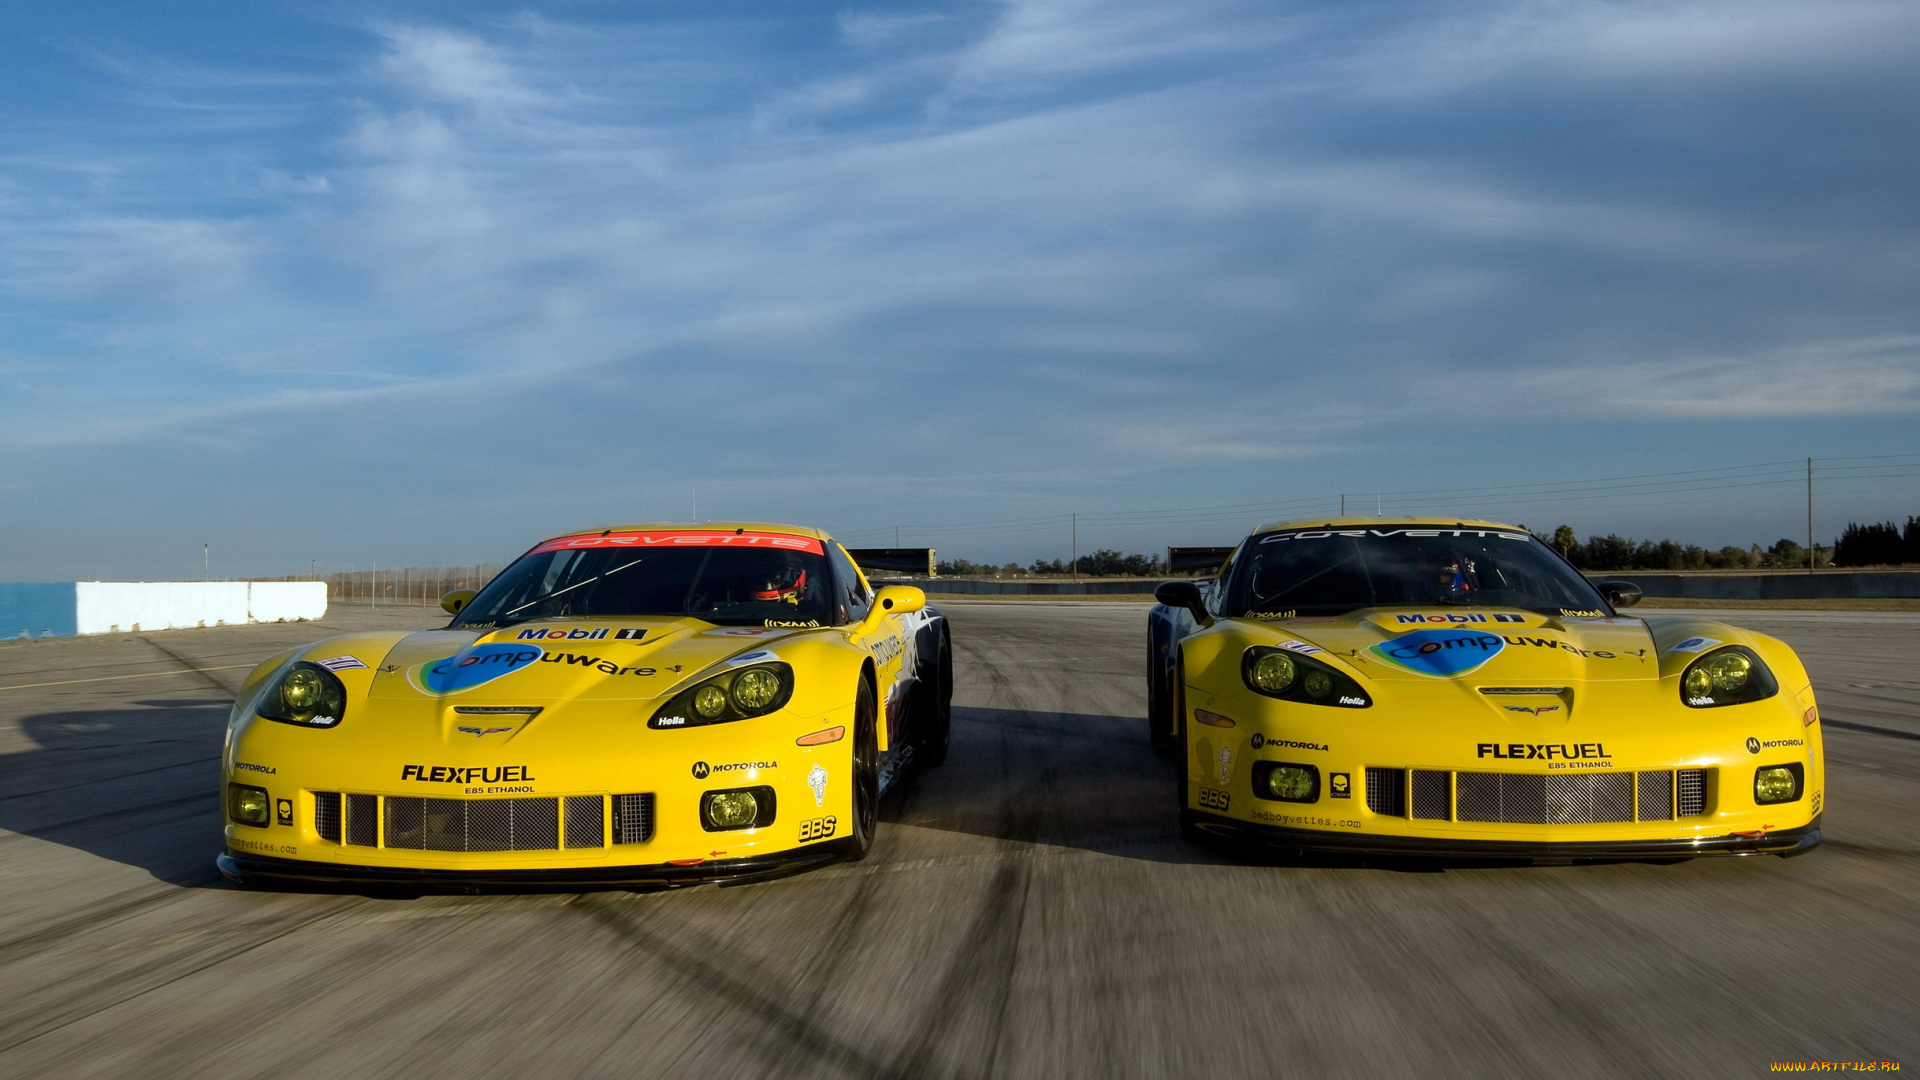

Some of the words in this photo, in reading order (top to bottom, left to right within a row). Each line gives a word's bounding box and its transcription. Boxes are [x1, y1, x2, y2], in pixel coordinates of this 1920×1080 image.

[543, 536, 810, 549] CORVETTE
[1258, 529, 1530, 545] CORVETTE
[1396, 614, 1487, 624] Mobil
[516, 628, 611, 640] Mobil
[1339, 696, 1366, 706] Hella
[1689, 696, 1715, 706] Hella
[658, 716, 685, 726] Hella
[1266, 739, 1330, 751] MOTOROLA
[1762, 738, 1804, 748] MOTOROLA
[1476, 743, 1613, 760] FLEXFUEL
[235, 761, 277, 775] MOTOROLA
[712, 761, 778, 773] MOTOROLA
[1569, 761, 1614, 769] ETHANOL
[401, 764, 536, 784] FLEXFUEL
[487, 785, 536, 794] ETHANOL
[1198, 787, 1231, 812] BBS
[1251, 808, 1362, 829] badboyvettes.com
[798, 815, 837, 843] BBS
